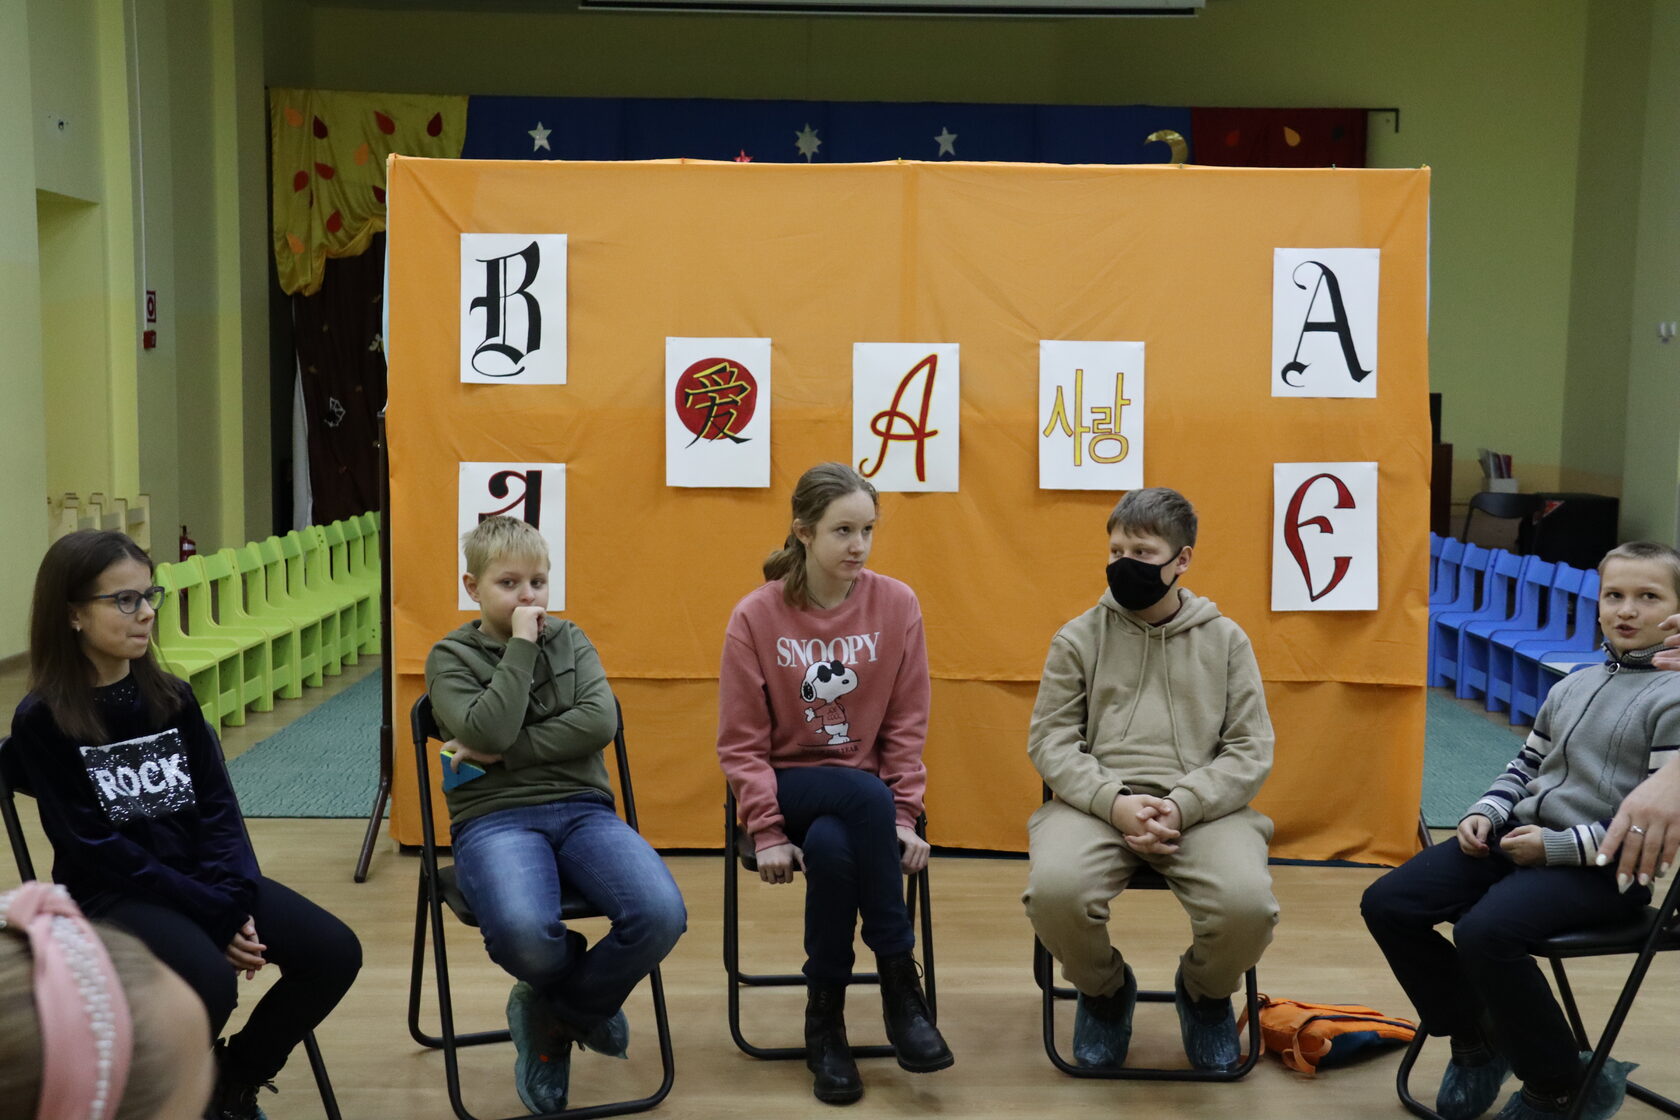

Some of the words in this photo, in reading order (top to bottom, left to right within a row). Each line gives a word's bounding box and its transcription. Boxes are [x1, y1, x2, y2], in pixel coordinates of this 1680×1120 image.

[469, 240, 542, 377] B
[1281, 260, 1373, 387] A
[858, 353, 939, 482] A
[1043, 369, 1131, 466] 사랑
[776, 632, 880, 668] SNOOPY
[94, 753, 191, 801] ROCK
